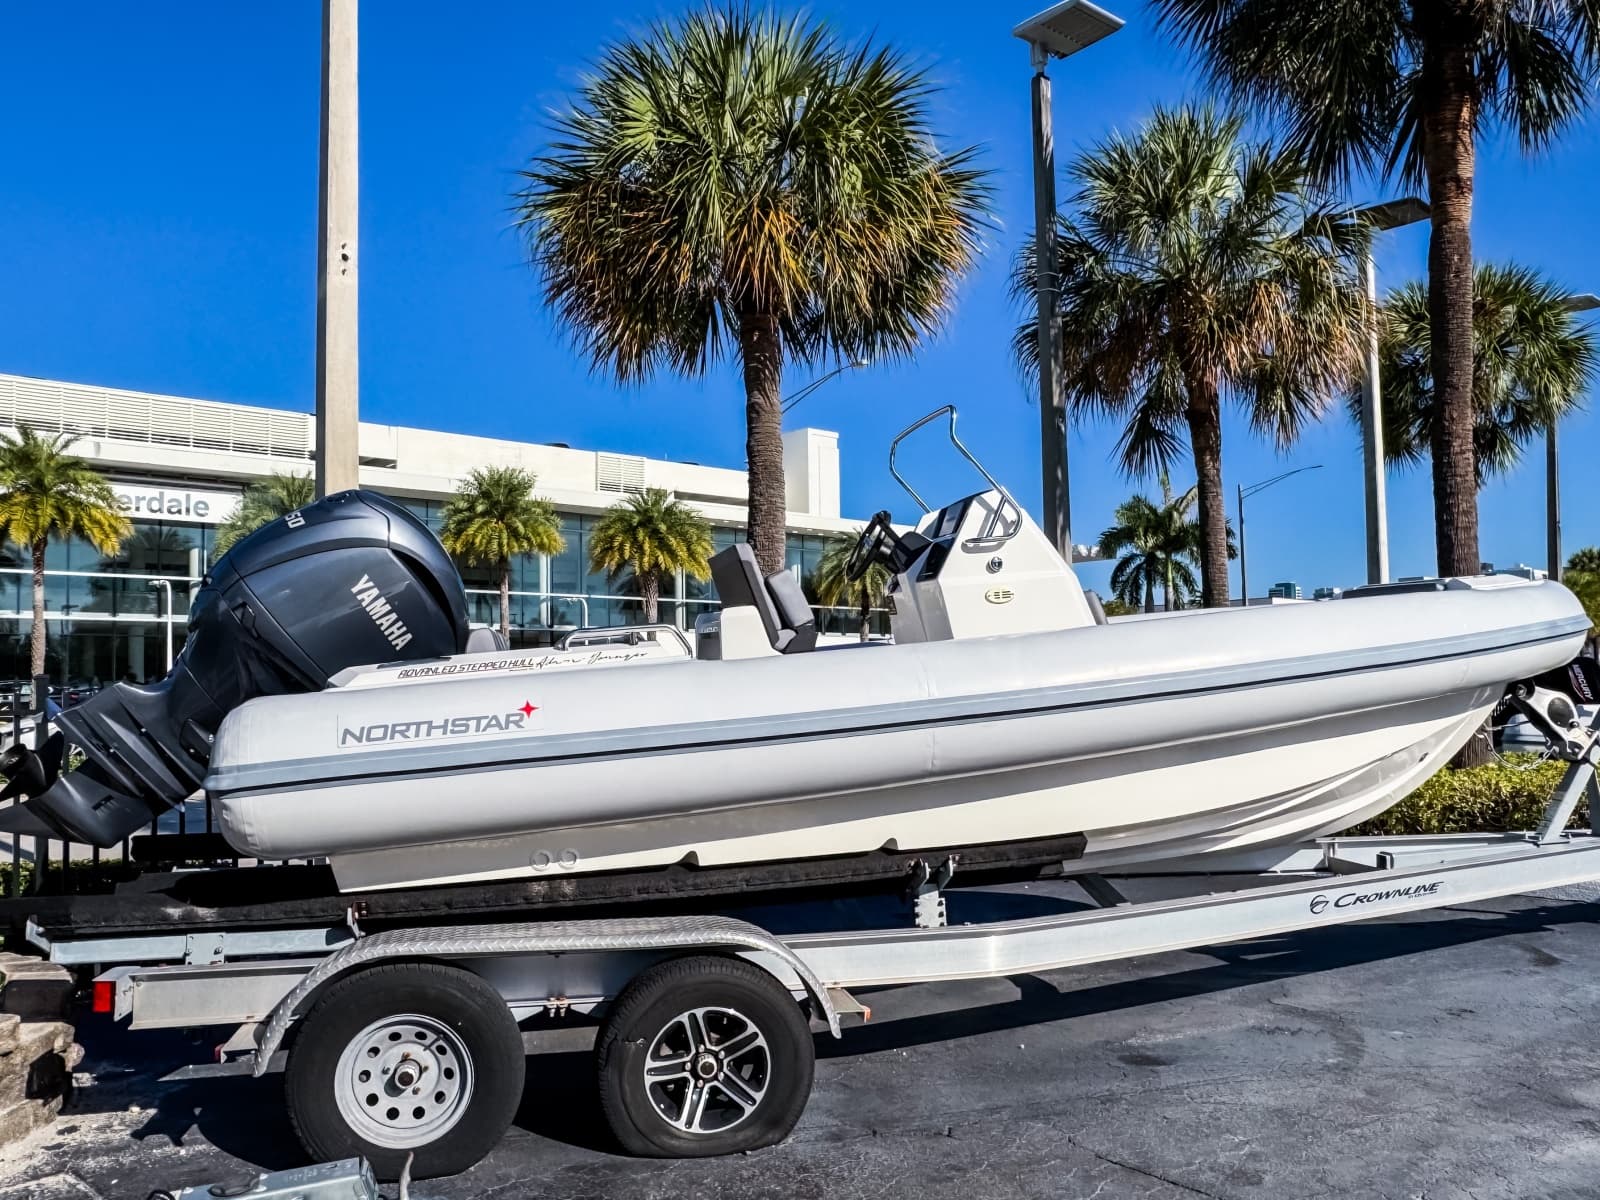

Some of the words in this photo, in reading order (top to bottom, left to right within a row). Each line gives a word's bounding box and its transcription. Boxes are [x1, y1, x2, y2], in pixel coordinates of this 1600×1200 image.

[116, 491, 210, 518] erdale
[350, 573, 413, 650] YAMAHA
[457, 660, 508, 673] STEPPED
[508, 657, 534, 668] HULL
[1571, 664, 1594, 700] MERCURY
[340, 712, 526, 746] NORTHSTAR
[1333, 881, 1445, 908] CROWNLINE
